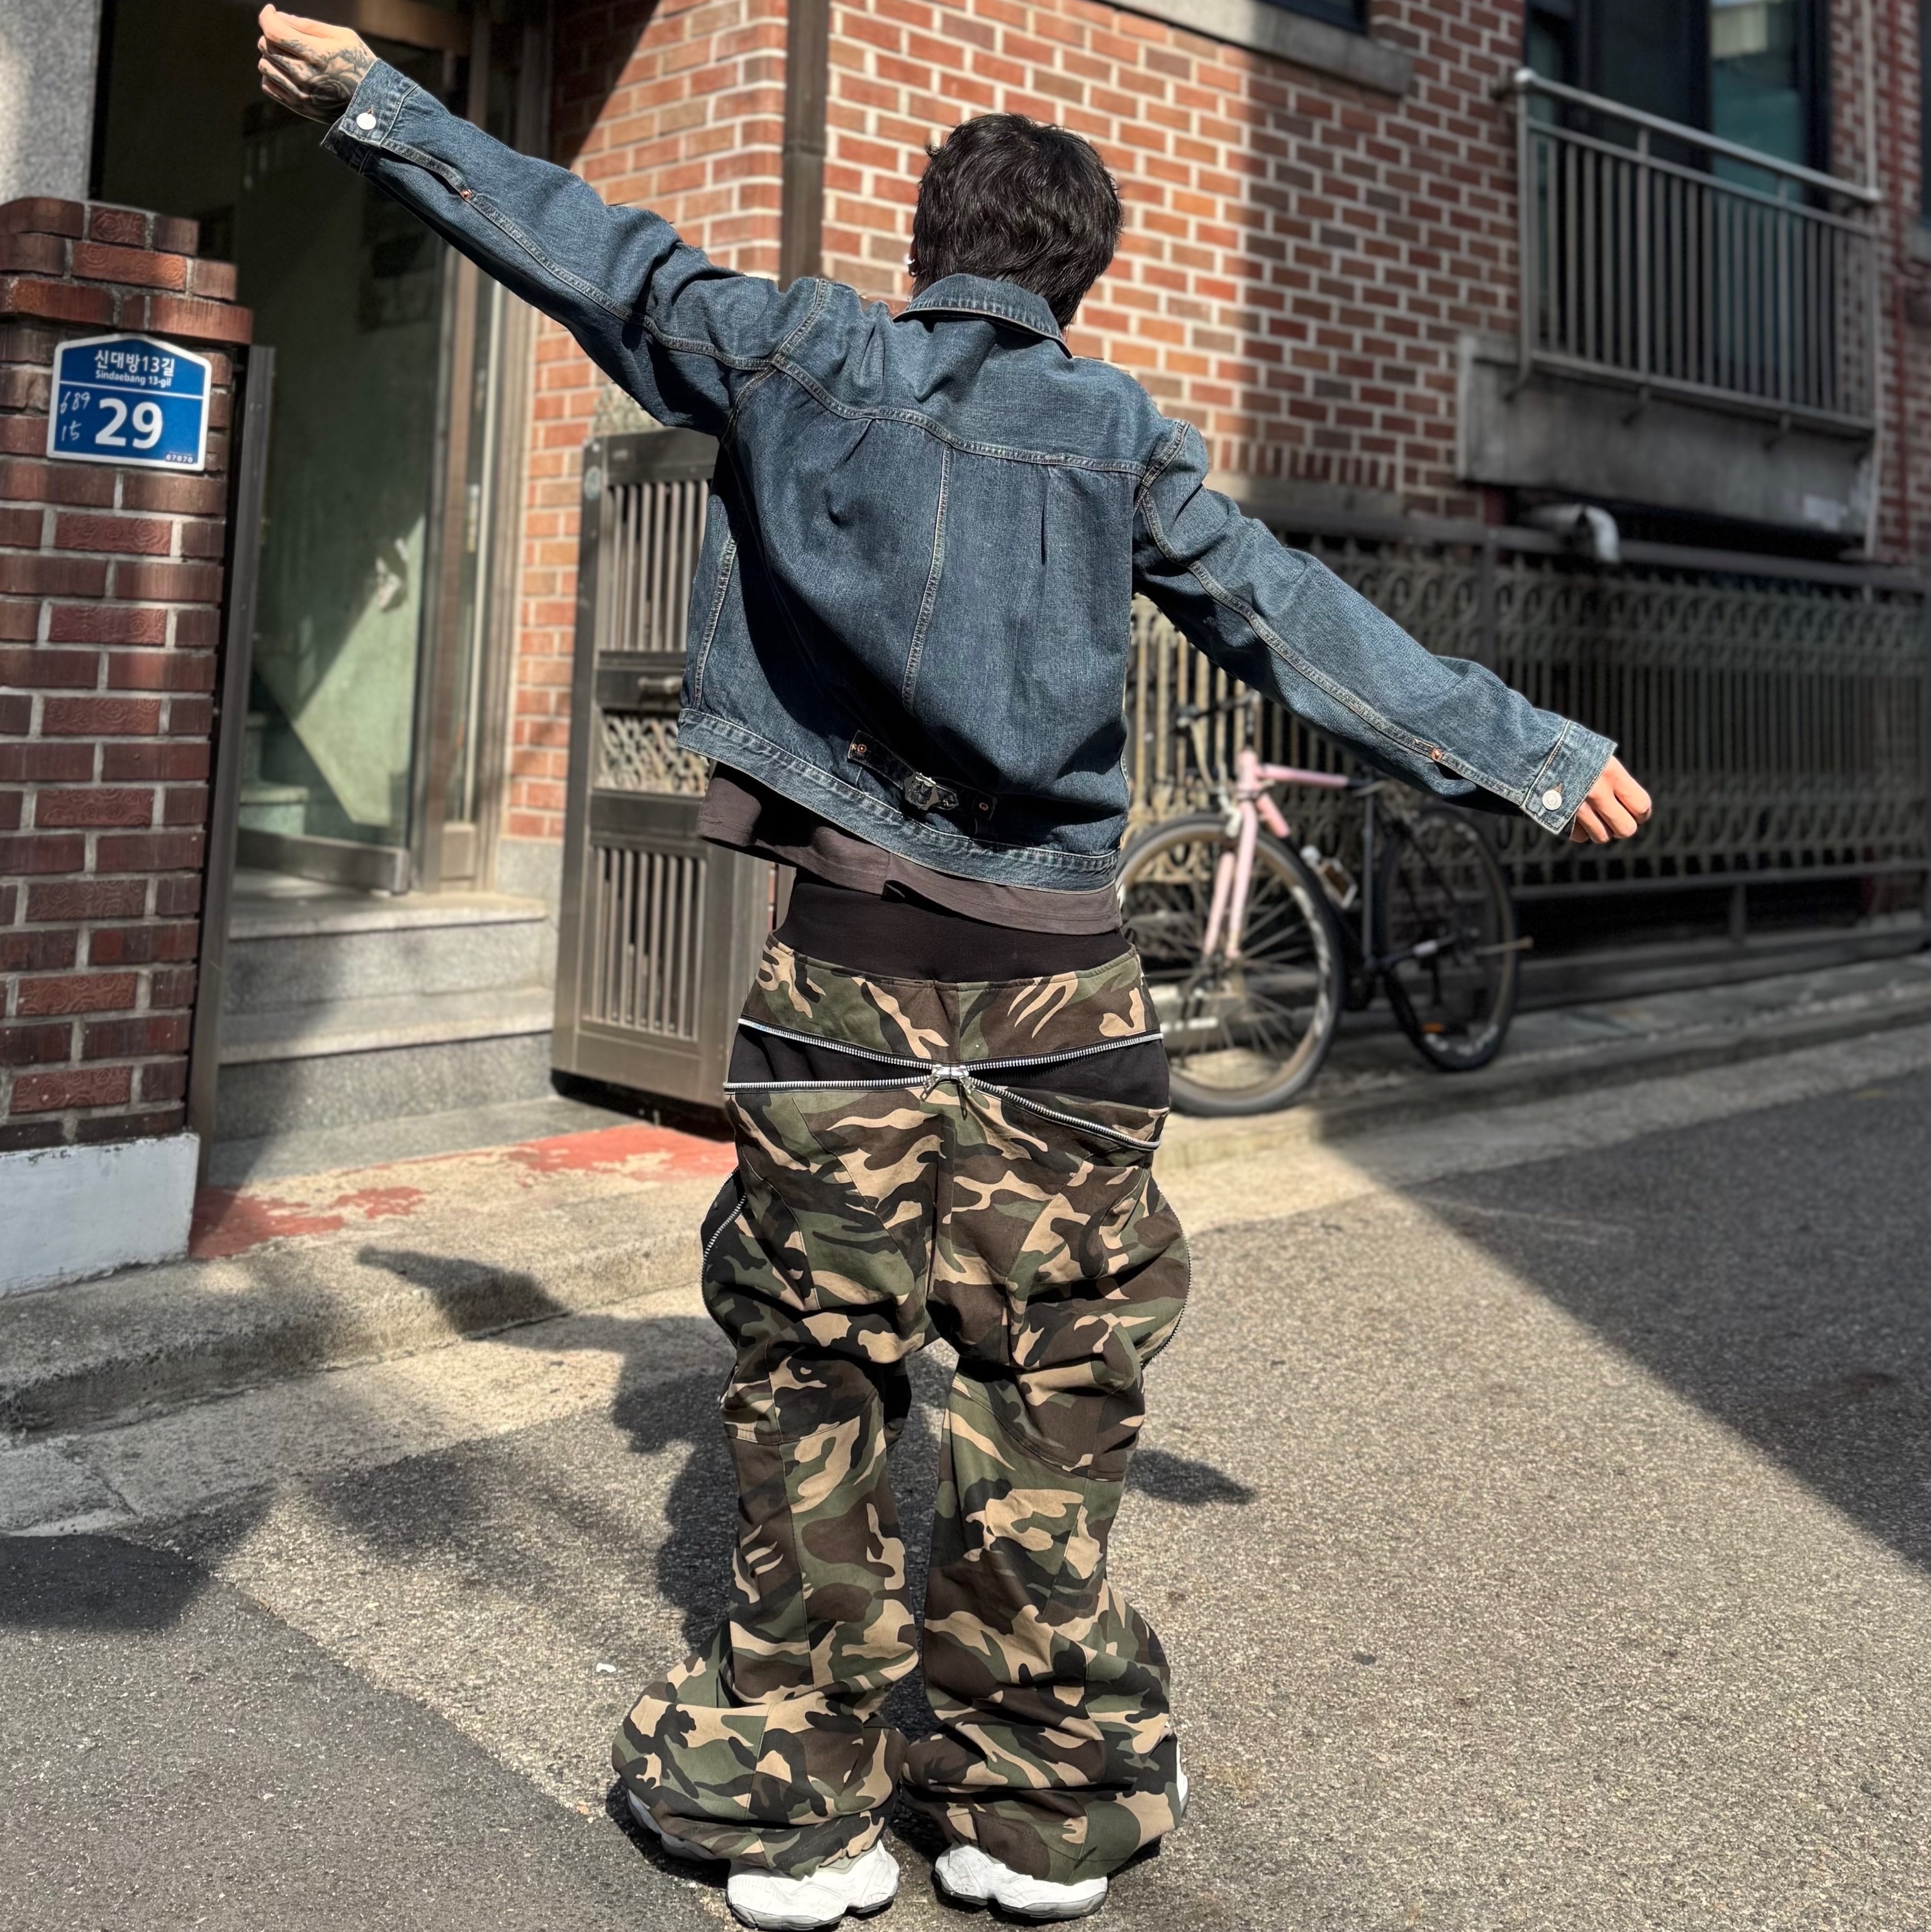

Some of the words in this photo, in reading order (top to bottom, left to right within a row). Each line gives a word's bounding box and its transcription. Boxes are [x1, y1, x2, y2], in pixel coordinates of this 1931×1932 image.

[94, 350, 175, 377] 신대방13길
[96, 369, 146, 386] Sindaebang
[148, 376, 172, 388] 13-gil
[60, 391, 91, 414] 689
[62, 420, 82, 442] 15
[95, 398, 163, 449] 29
